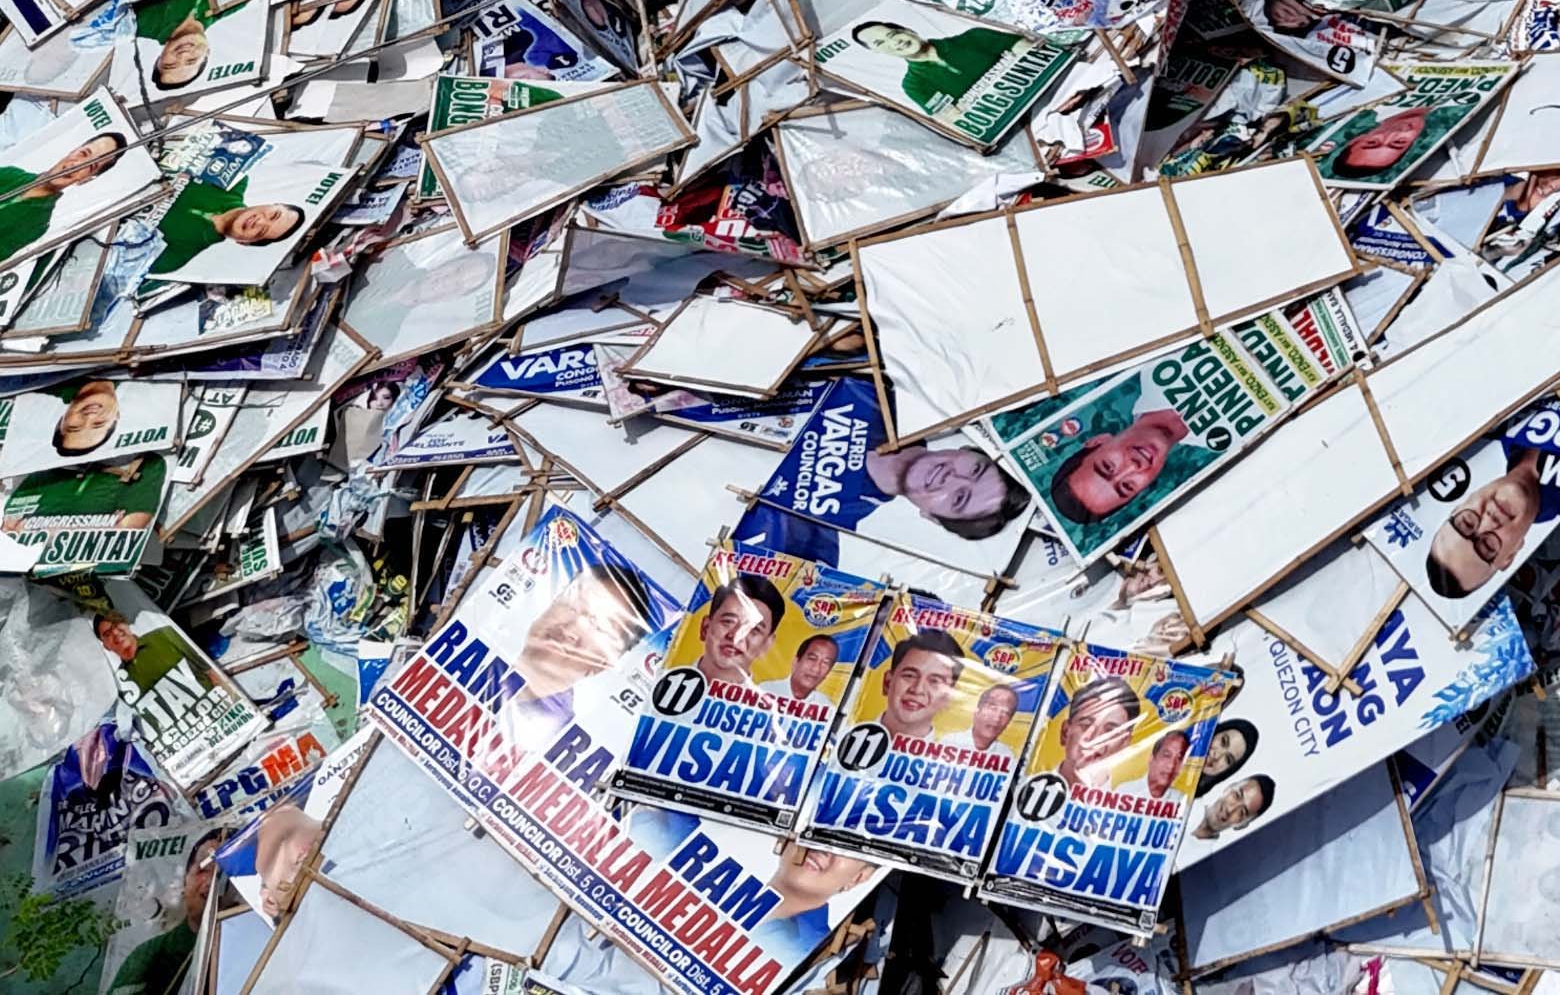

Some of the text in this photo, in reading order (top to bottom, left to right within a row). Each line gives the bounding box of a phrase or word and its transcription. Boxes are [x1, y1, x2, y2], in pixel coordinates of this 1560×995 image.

[206, 59, 255, 82] VOTE!
[814, 37, 851, 64] VOTE!
[81, 98, 113, 133] VOTE!
[954, 43, 1061, 139] BONG SUNTAY
[305, 171, 341, 207] VOTE!
[1152, 358, 1211, 439] ENZO
[1181, 340, 1266, 438] PINEDA
[115, 426, 169, 448] VOTE!
[810, 403, 854, 519] VARGAS
[847, 416, 866, 472] ALFRED
[793, 429, 817, 512] COUNCILOR
[23, 510, 124, 529] CONGRESSMAN
[45, 529, 147, 564] SUNTAY
[425, 620, 527, 715] RAM
[662, 673, 698, 712] 11
[374, 690, 440, 754] COUNCILOR
[708, 680, 829, 723] KONSEHAL
[1268, 641, 1320, 758] QUEZON CITY
[626, 717, 809, 806] VISAYA
[846, 730, 882, 767] 11
[879, 754, 1008, 802] JOSEPH JOE
[892, 735, 1011, 773] KONSEHAL
[812, 770, 993, 858] VISAYA
[1024, 780, 1060, 815] 11
[1057, 805, 1143, 844] JOSEPH
[134, 835, 189, 861] VOTE!
[492, 798, 561, 863] COUNCILOR
[509, 762, 645, 898] MEDALLA
[667, 831, 784, 931] RAM
[994, 824, 1168, 907] VISAYA
[616, 903, 690, 972] COUNCILOR
[636, 866, 783, 994] MEDALLA
